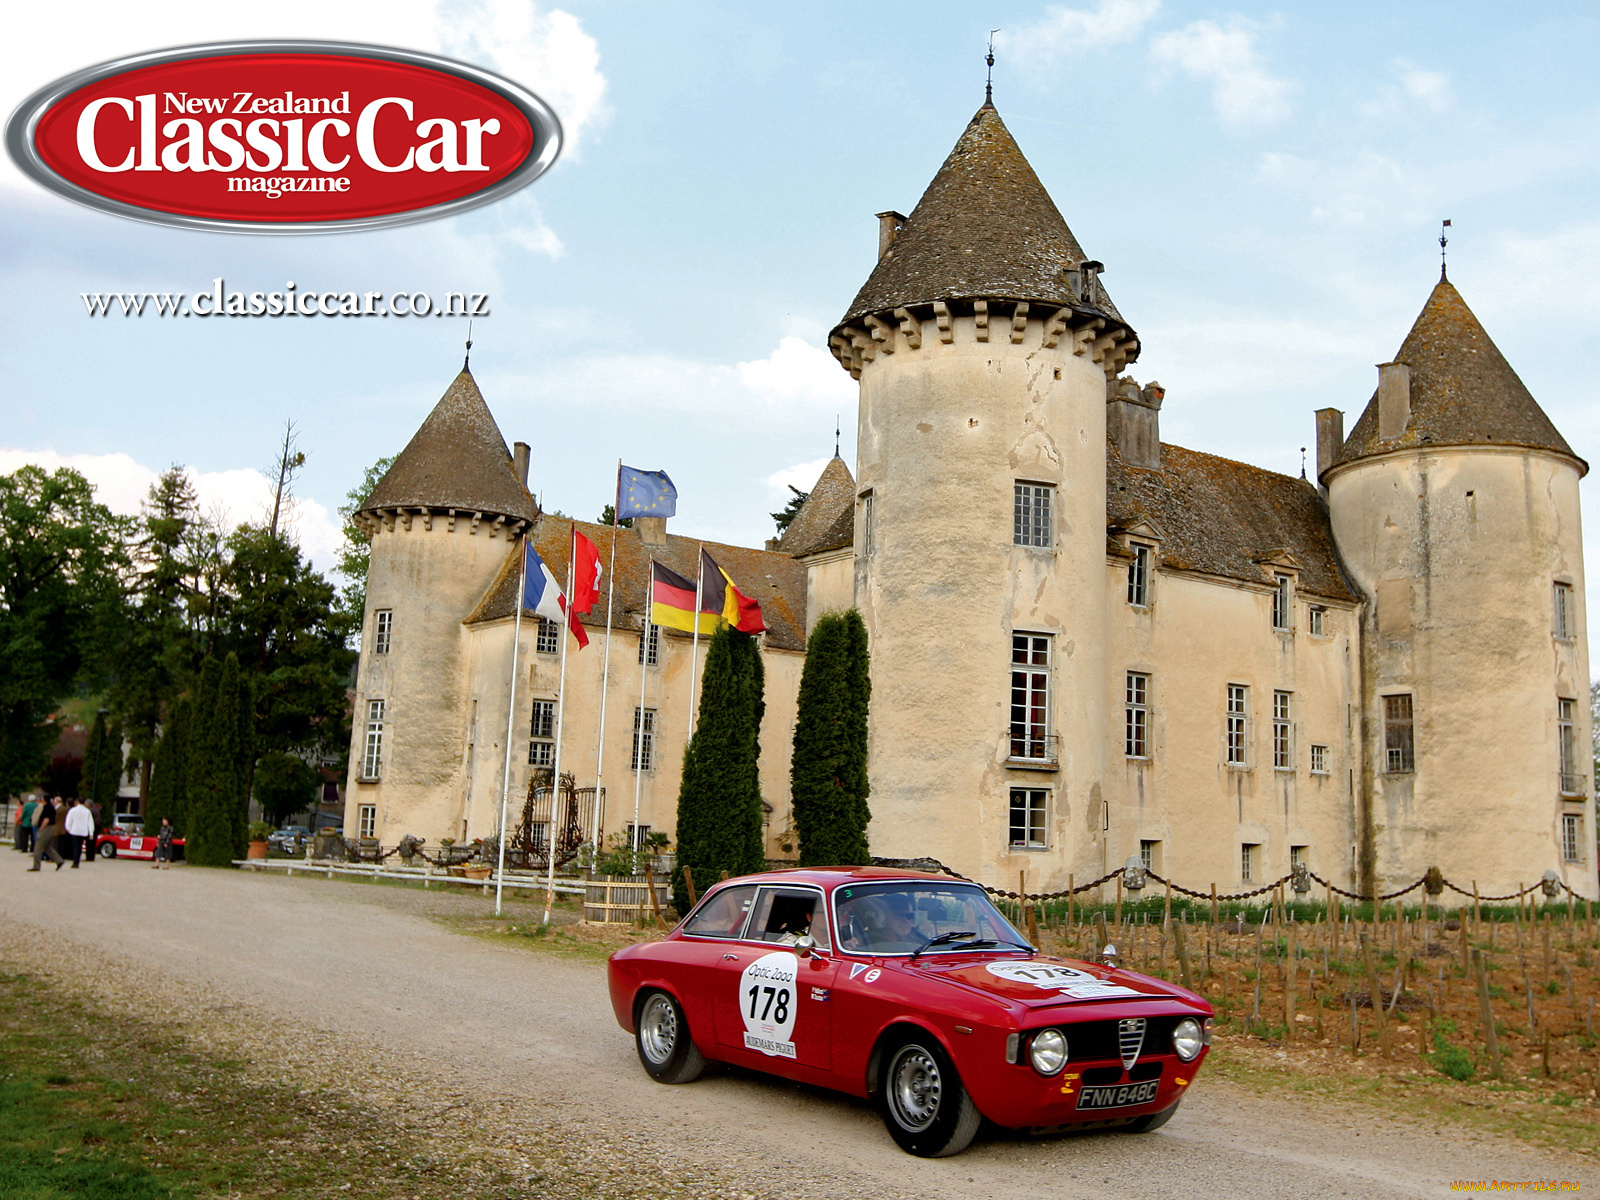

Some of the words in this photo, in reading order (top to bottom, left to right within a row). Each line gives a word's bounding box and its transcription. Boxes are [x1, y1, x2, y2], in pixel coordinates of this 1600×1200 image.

[844, 889, 853, 898] 3
[748, 964, 770, 981] Optic
[771, 967, 793, 983] 2000
[1014, 967, 1081, 981] 178
[749, 985, 790, 1025] 178
[1079, 1088, 1116, 1107] FNN
[1116, 1082, 1157, 1104] 848C
